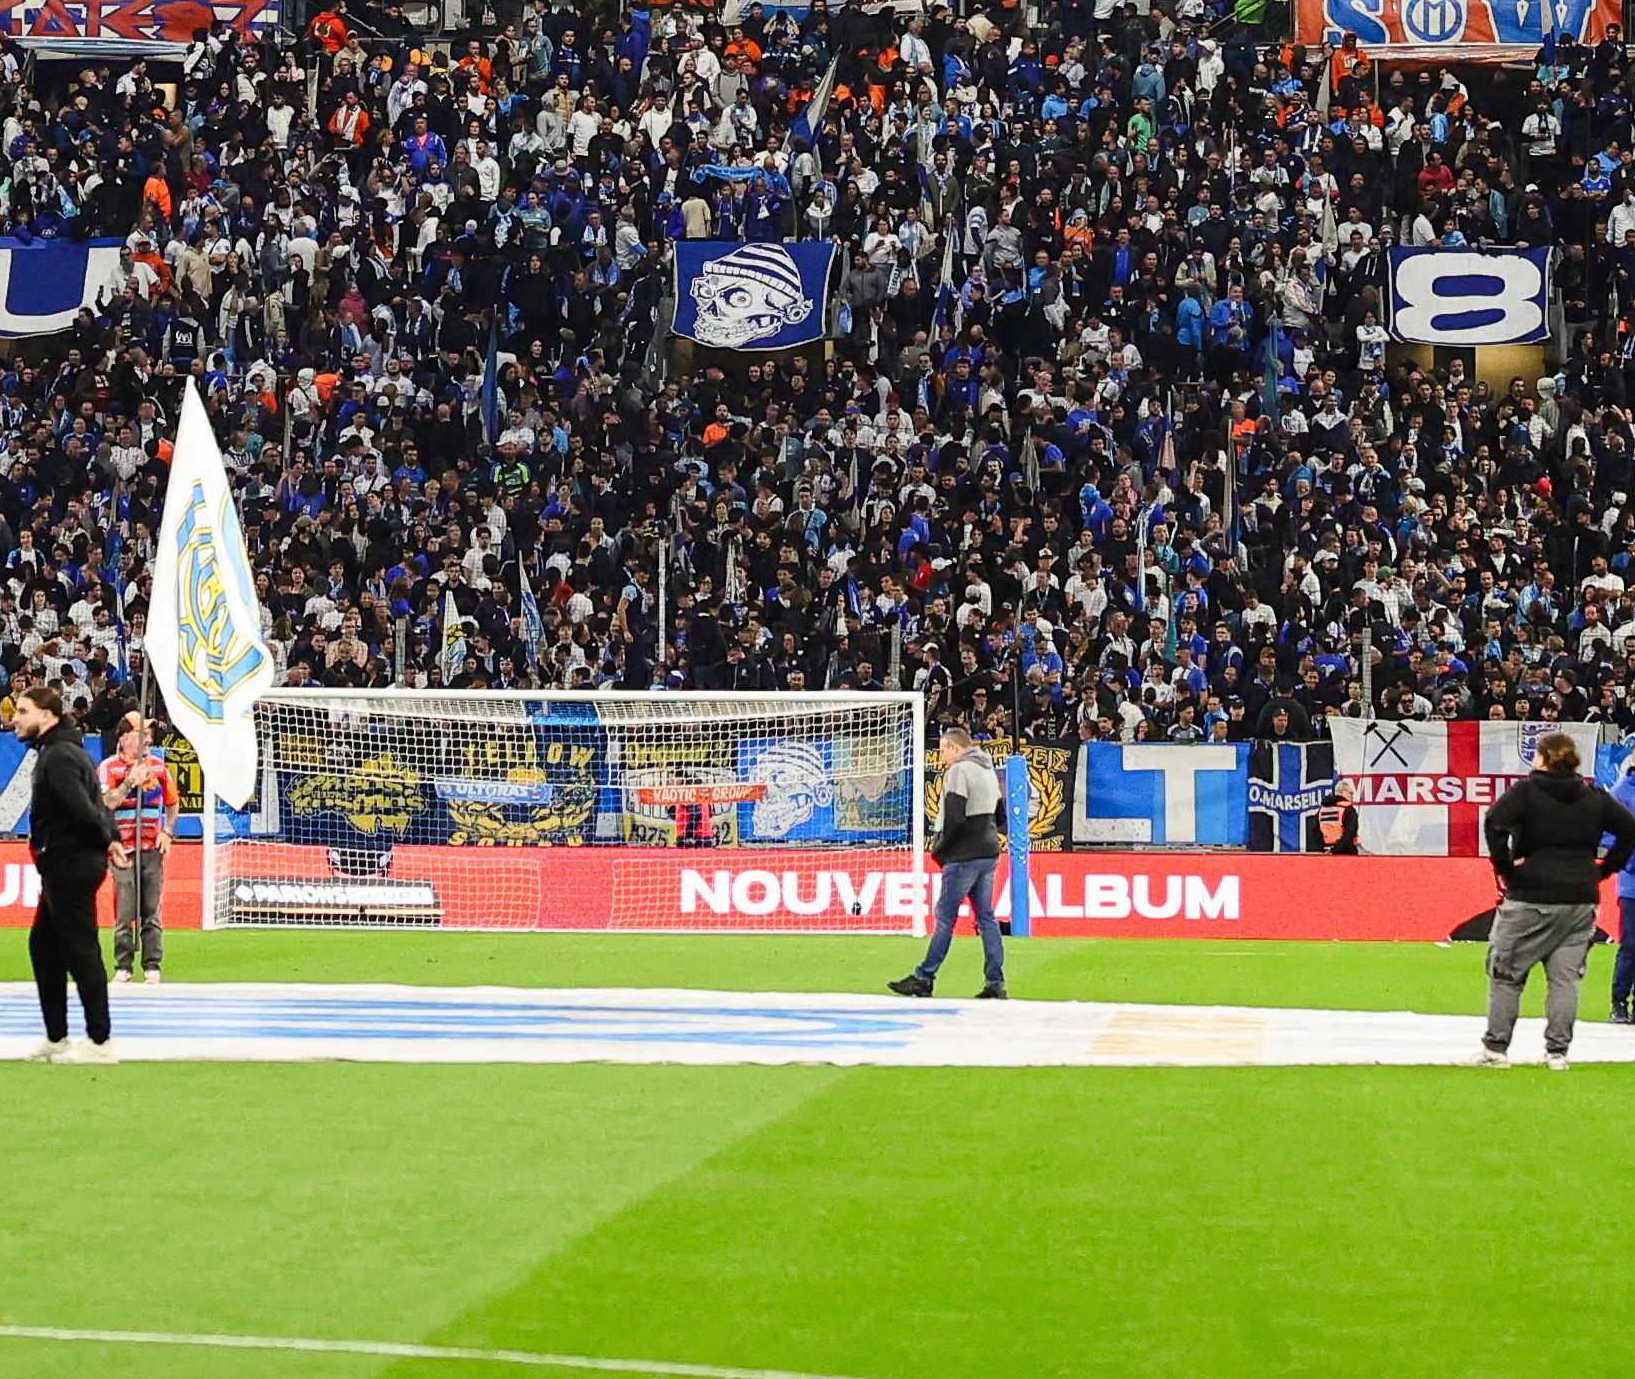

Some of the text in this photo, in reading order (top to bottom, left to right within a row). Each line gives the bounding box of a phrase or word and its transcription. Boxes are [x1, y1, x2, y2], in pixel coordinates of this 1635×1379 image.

[1394, 250, 1546, 345] 8
[652, 786, 697, 803] KAOTIC
[1349, 776, 1521, 803] MARSEI
